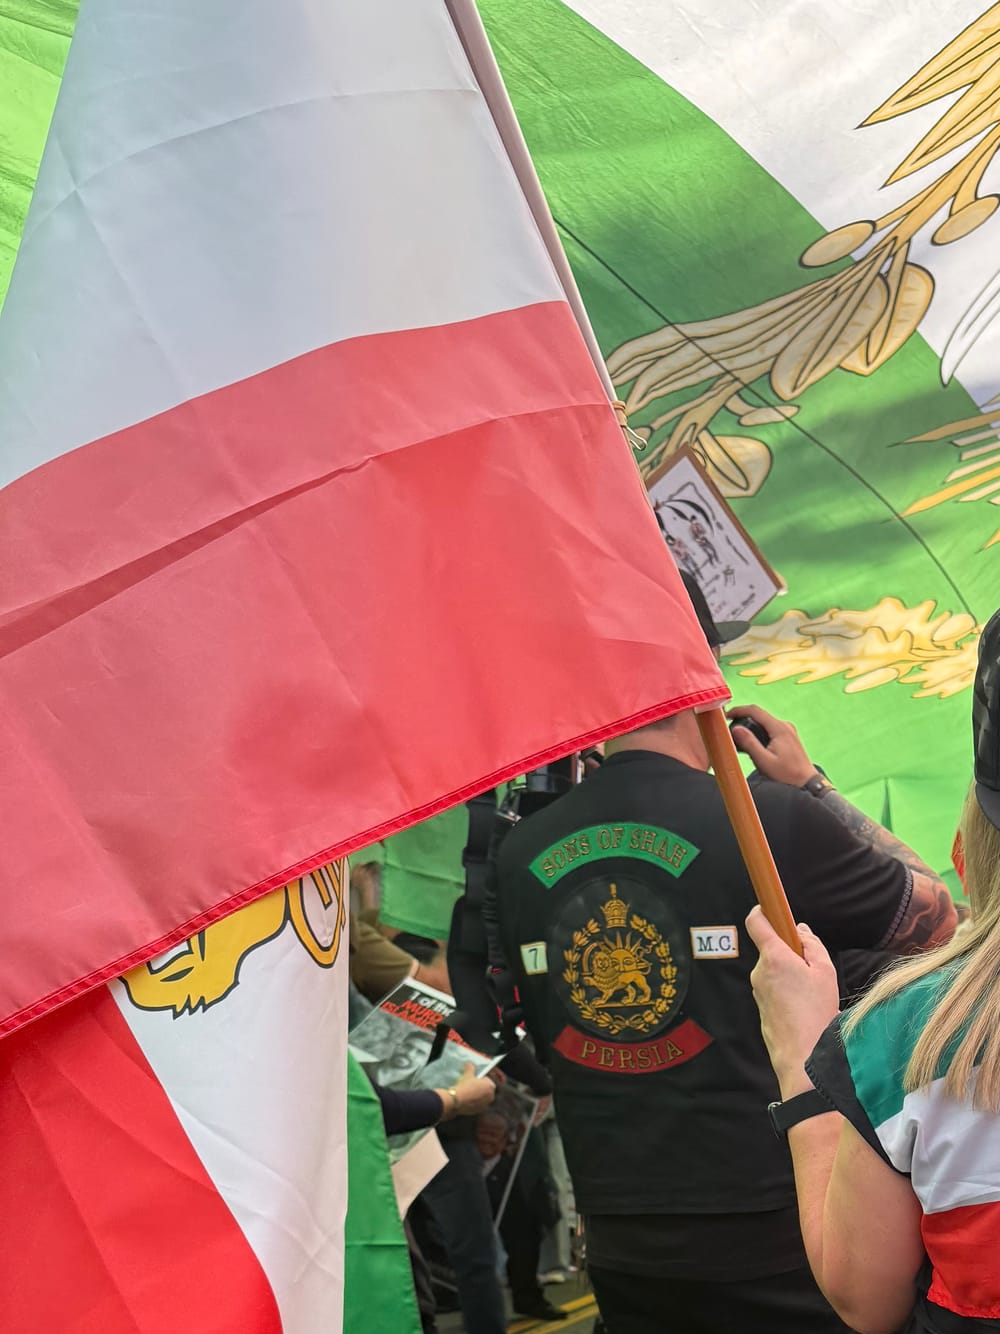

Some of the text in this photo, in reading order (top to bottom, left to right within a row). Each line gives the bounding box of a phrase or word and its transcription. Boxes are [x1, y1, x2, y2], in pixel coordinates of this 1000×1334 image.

[540, 827, 688, 878] SONS OF SHAH
[697, 935, 736, 952] M.C.
[528, 947, 541, 970] 7
[400, 1000, 445, 1023] MURD
[580, 1040, 683, 1070] PERSIA
